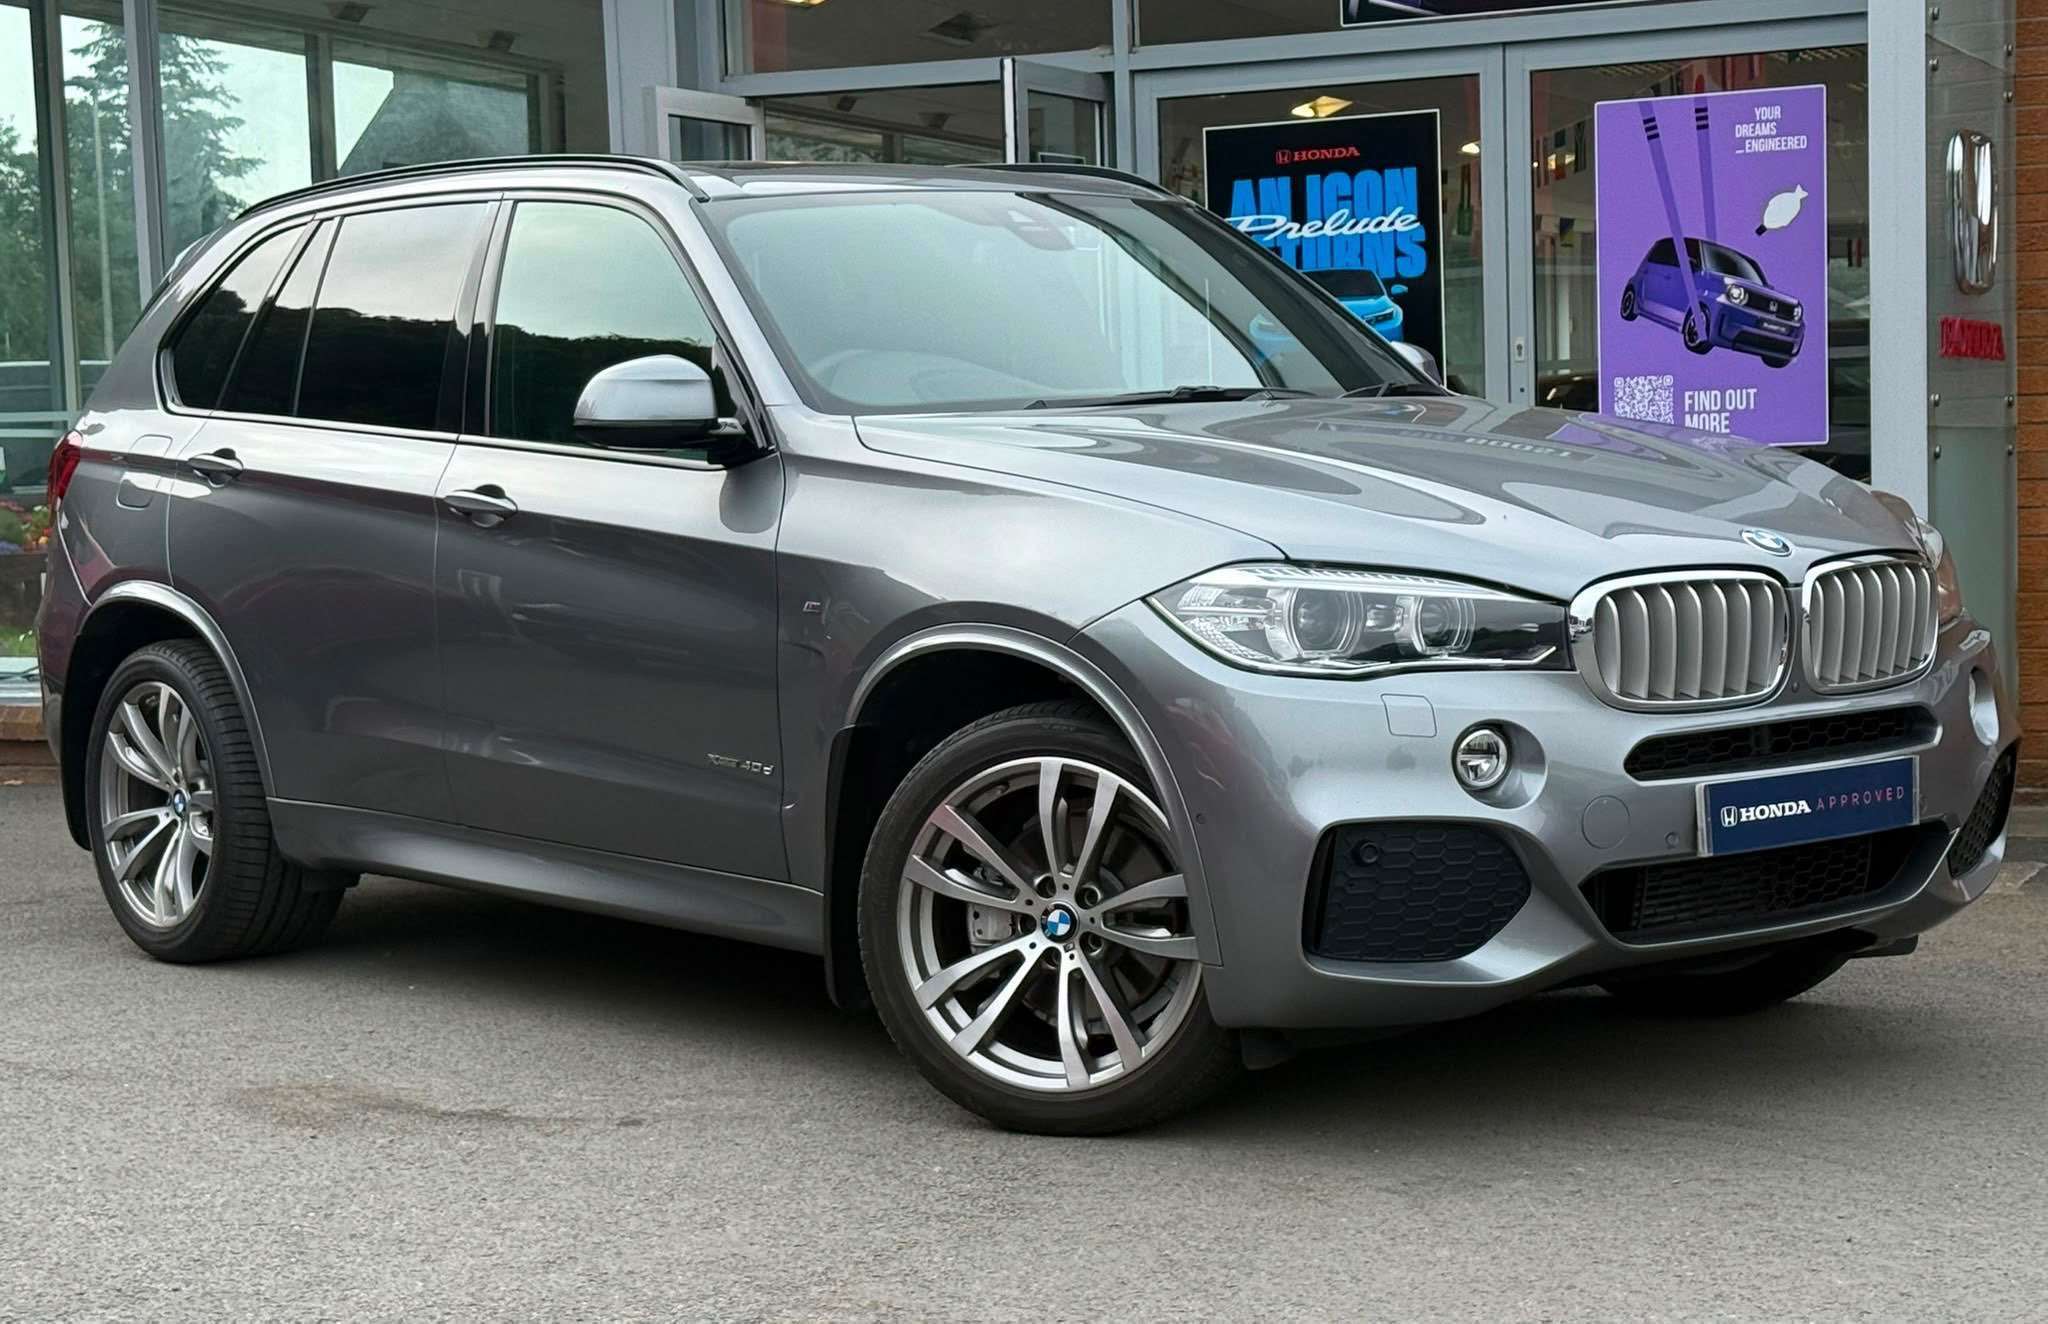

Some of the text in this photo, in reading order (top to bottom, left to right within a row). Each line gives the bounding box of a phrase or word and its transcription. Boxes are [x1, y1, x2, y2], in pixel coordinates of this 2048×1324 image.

[1754, 105, 1781, 121] YOUR
[1735, 122, 1777, 138] DREAMS
[1293, 147, 1360, 161] HONDA
[1231, 176, 1292, 226] AN
[1305, 167, 1418, 224] ICON
[1225, 206, 1420, 242] Prelude
[1684, 388, 1757, 411] FIND OUT
[1684, 412, 1730, 433] MORE
[1740, 786, 1905, 822] HONDA APPROVED
